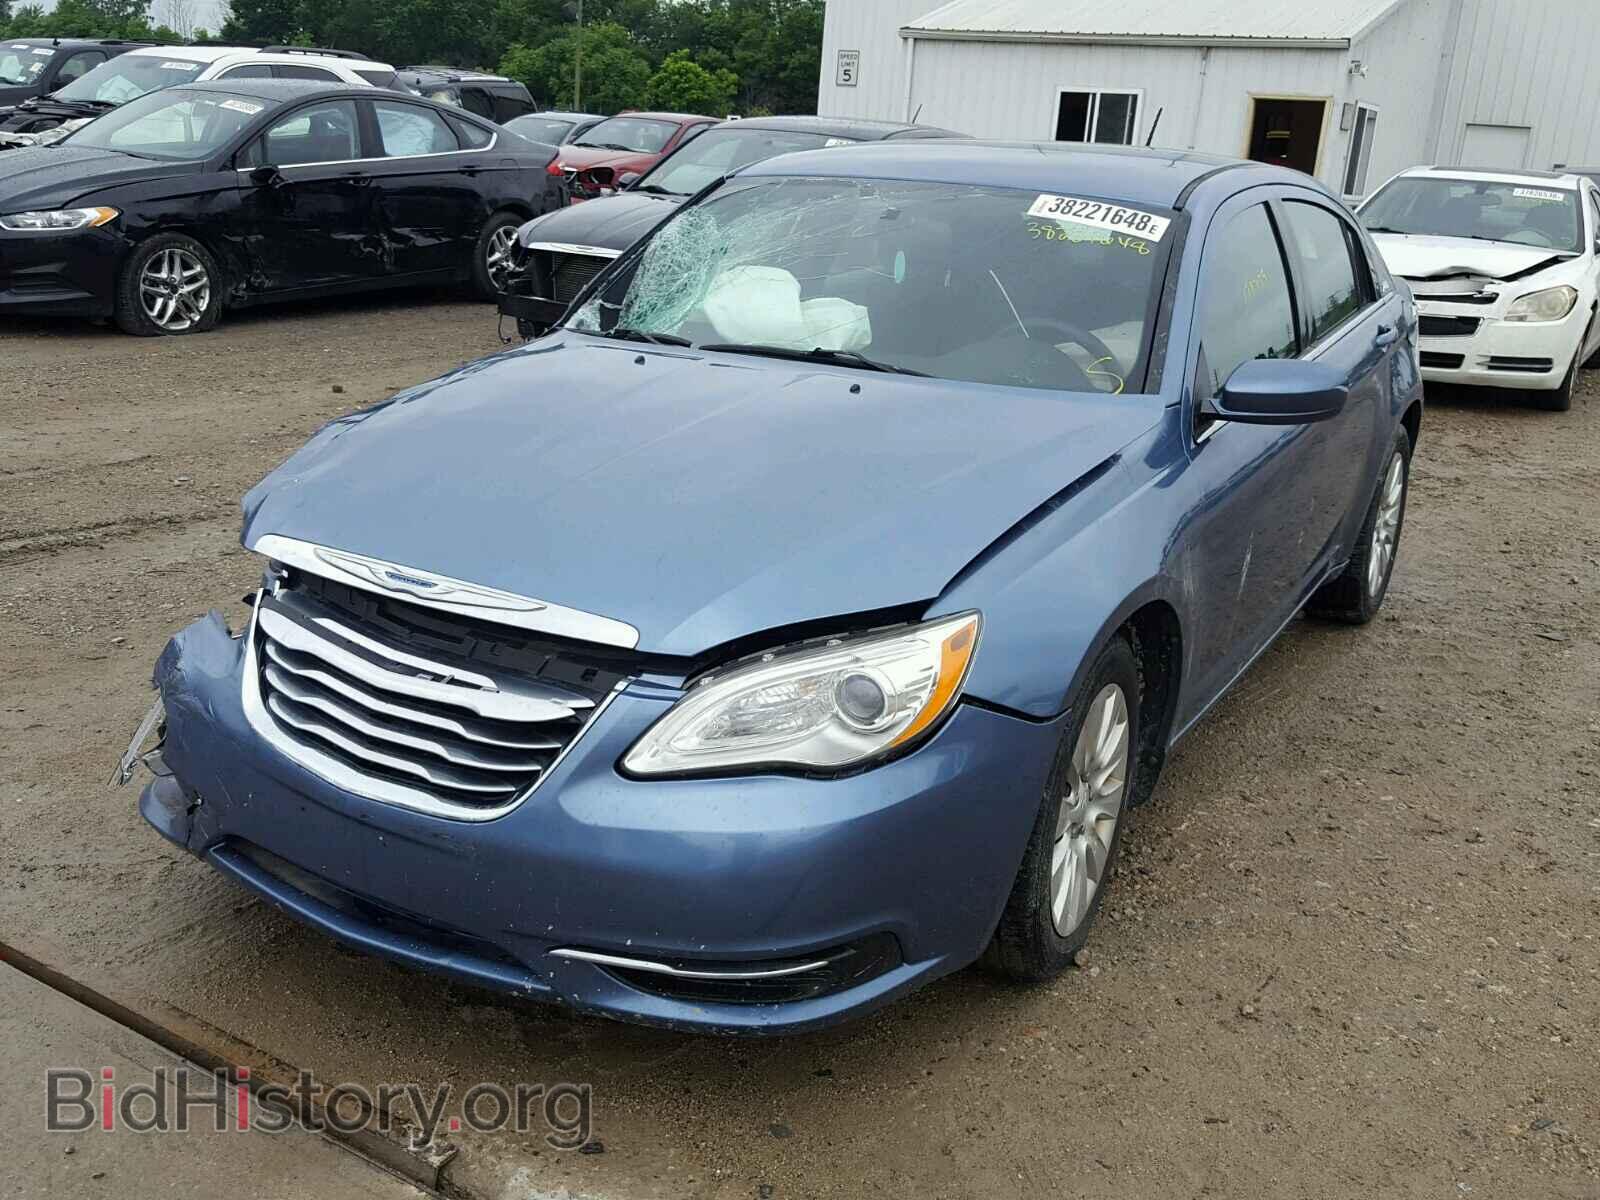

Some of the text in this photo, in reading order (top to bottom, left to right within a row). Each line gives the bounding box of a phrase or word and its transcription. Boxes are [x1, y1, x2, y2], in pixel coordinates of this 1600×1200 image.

[842, 69, 852, 82] 5
[1048, 197, 1151, 232] 38221648
[1148, 224, 1159, 235] E
